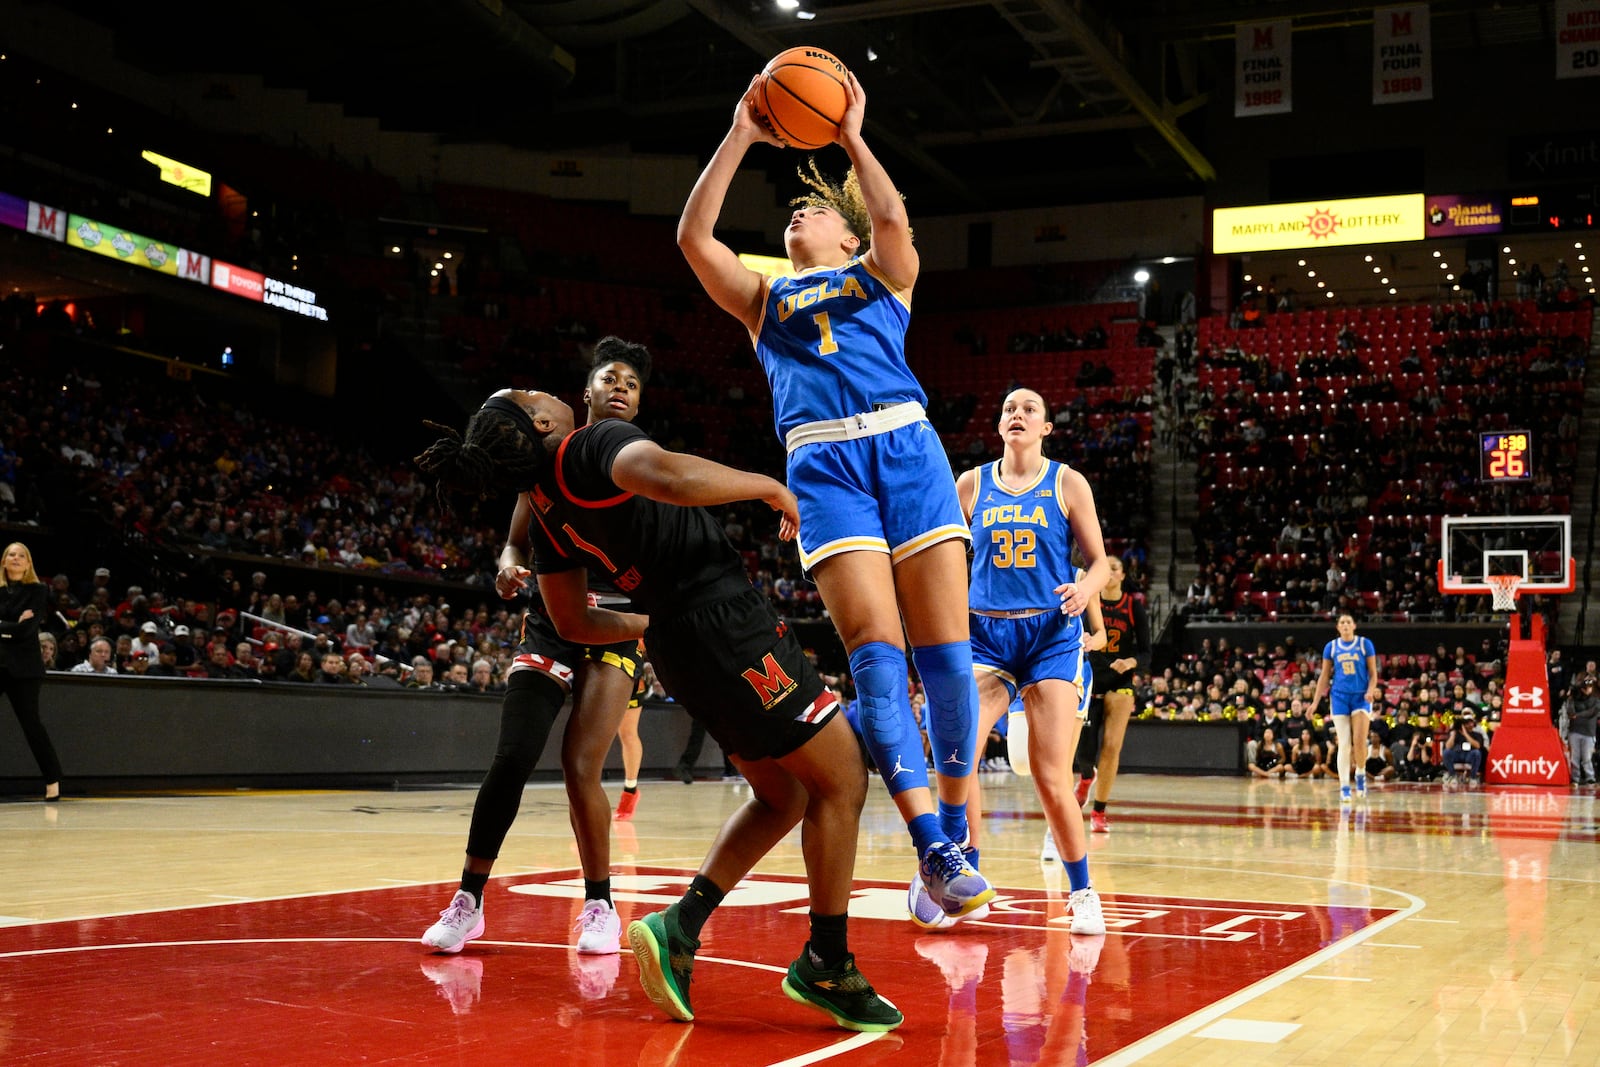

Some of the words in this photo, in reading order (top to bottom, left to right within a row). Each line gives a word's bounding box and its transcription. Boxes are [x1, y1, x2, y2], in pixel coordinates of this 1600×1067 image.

[1391, 12, 1411, 36] M
[1253, 26, 1273, 49] M
[1381, 43, 1422, 57] FINAL
[1243, 57, 1282, 71] FINAL
[1383, 57, 1420, 70] FOUR
[1244, 71, 1281, 84] FOUR
[37, 203, 58, 234] M
[1448, 203, 1493, 219] planet
[1454, 213, 1502, 227] fitness
[1232, 220, 1305, 236] MARYLAND
[1339, 214, 1401, 229] LOTTERY
[186, 251, 202, 279] M
[231, 274, 263, 293] TOYOTA
[264, 277, 285, 295] FOR
[776, 276, 868, 323] UCLA
[812, 311, 840, 357] 1
[1490, 451, 1524, 477] 26
[982, 504, 1049, 529] UCLA
[991, 529, 1038, 569] 32
[1337, 653, 1360, 663] UCLA
[740, 651, 795, 707] M
[1491, 753, 1561, 781] xfinity
